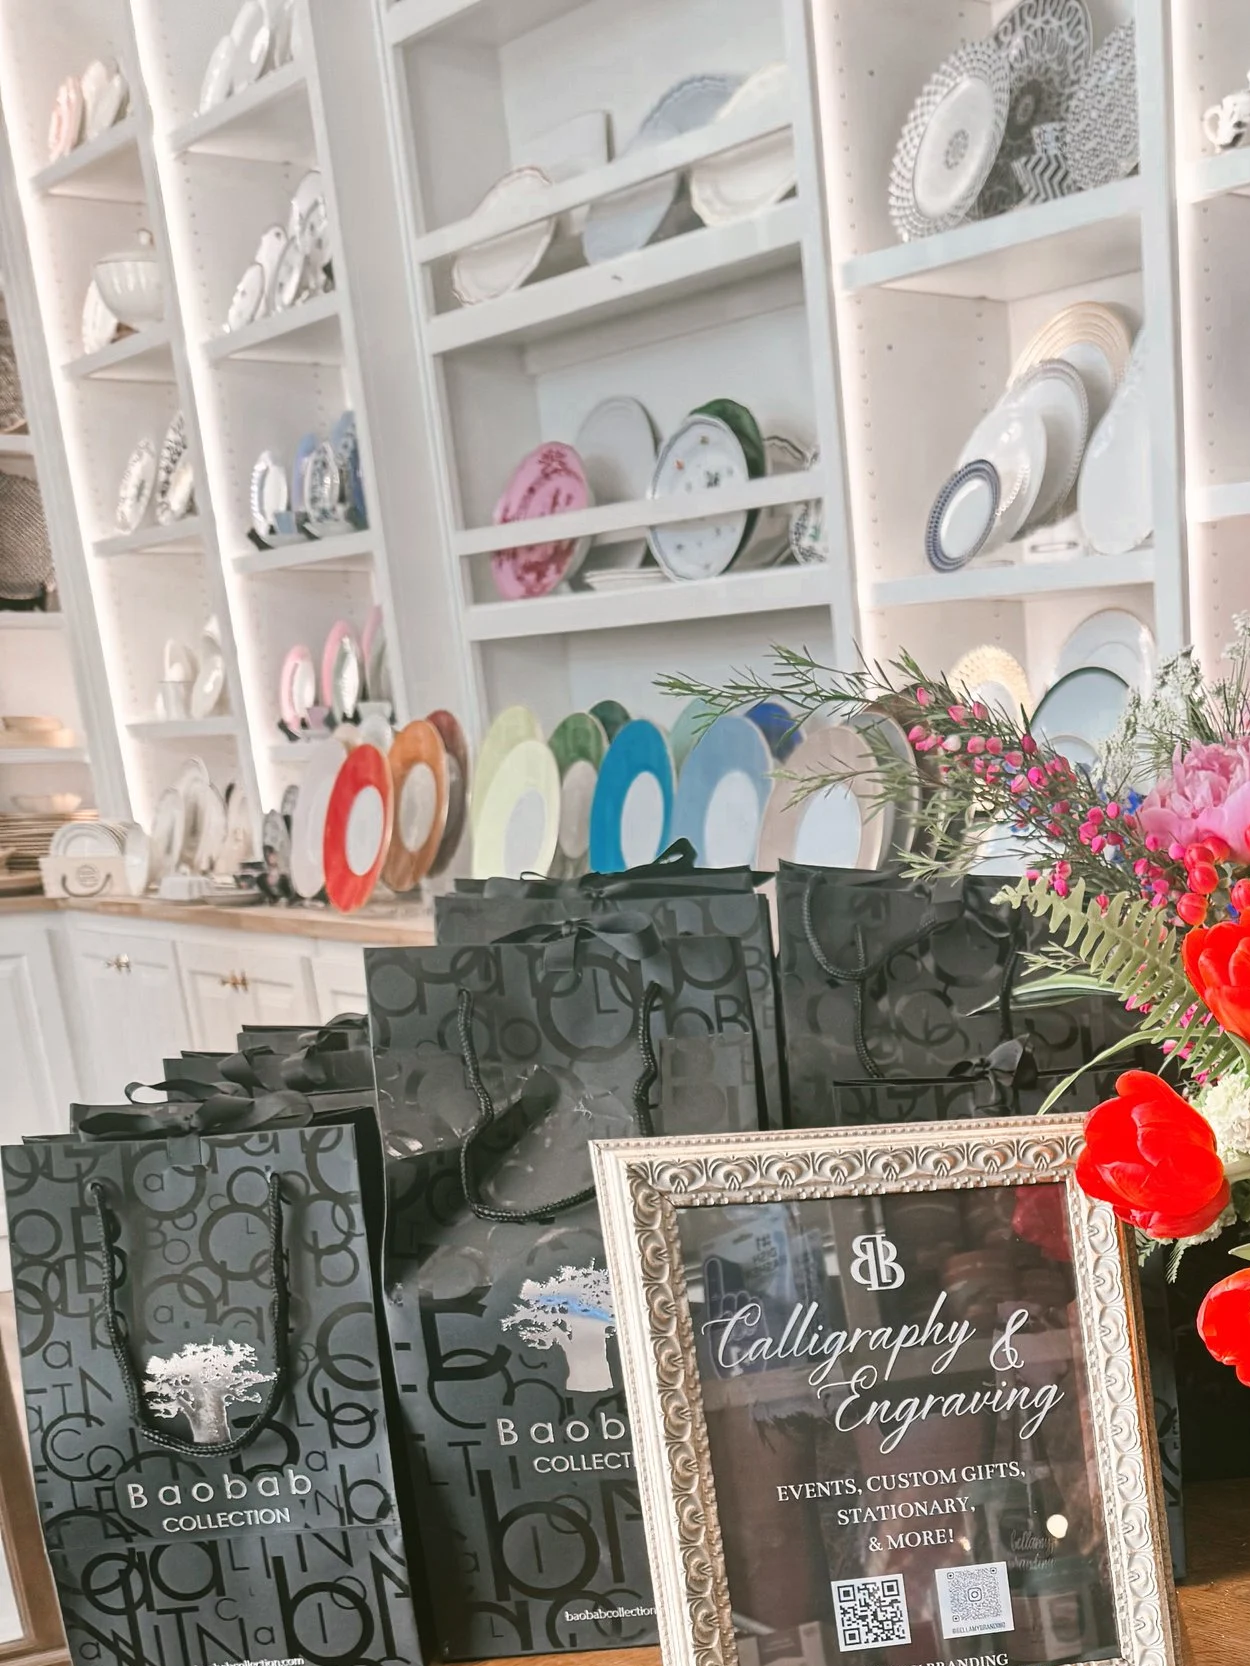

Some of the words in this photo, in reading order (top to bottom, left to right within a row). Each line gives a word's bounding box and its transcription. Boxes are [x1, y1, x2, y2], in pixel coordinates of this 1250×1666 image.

[702, 1291, 976, 1386] Calligraphy
[989, 1309, 1029, 1371] &
[818, 1365, 1064, 1454] Engraving
[496, 1412, 626, 1446] Baob
[533, 1451, 636, 1474] COLLECT
[127, 1469, 312, 1509] Baobab
[776, 1478, 863, 1502] EVENTS,
[866, 1467, 956, 1493] CUSTOM
[961, 1461, 1026, 1483] GIFTS,
[162, 1507, 291, 1533] COLLECTION
[837, 1496, 976, 1526] STATIONARY,
[868, 1536, 884, 1552] &
[887, 1528, 955, 1550] MORE!
[564, 1606, 658, 1622] baobabcollection
